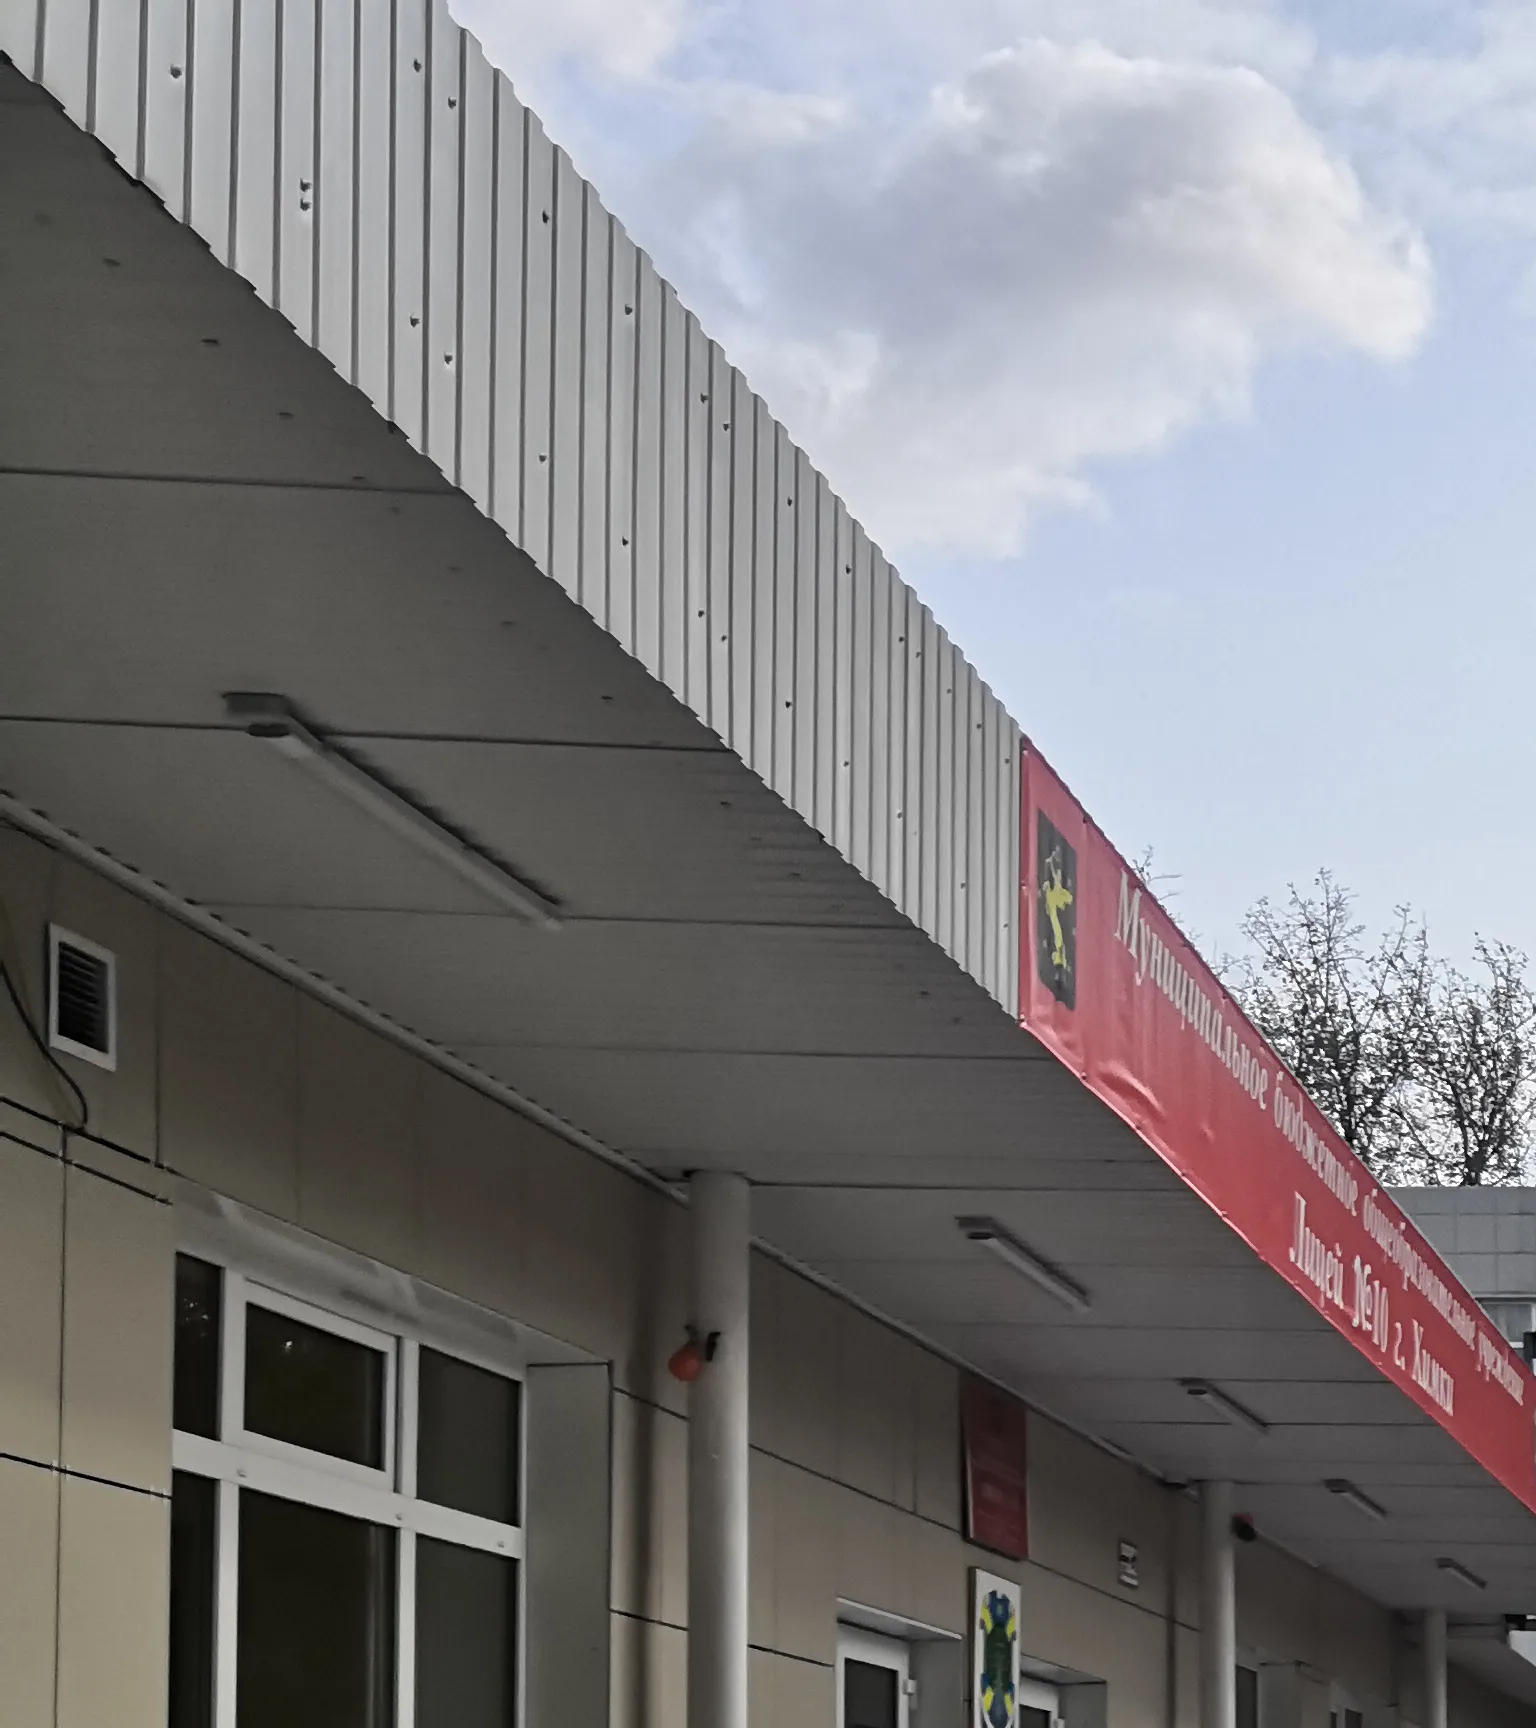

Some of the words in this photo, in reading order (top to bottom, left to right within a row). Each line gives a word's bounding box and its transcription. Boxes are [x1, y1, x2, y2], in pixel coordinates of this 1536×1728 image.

[1114, 867, 1268, 1110] Муниципальное
[1273, 1070, 1359, 1217] бюджетное
[1289, 1190, 1344, 1309] Лицей
[1352, 1254, 1389, 1353] №10
[1393, 1322, 1406, 1371] г.
[1412, 1318, 1455, 1416] Химки
